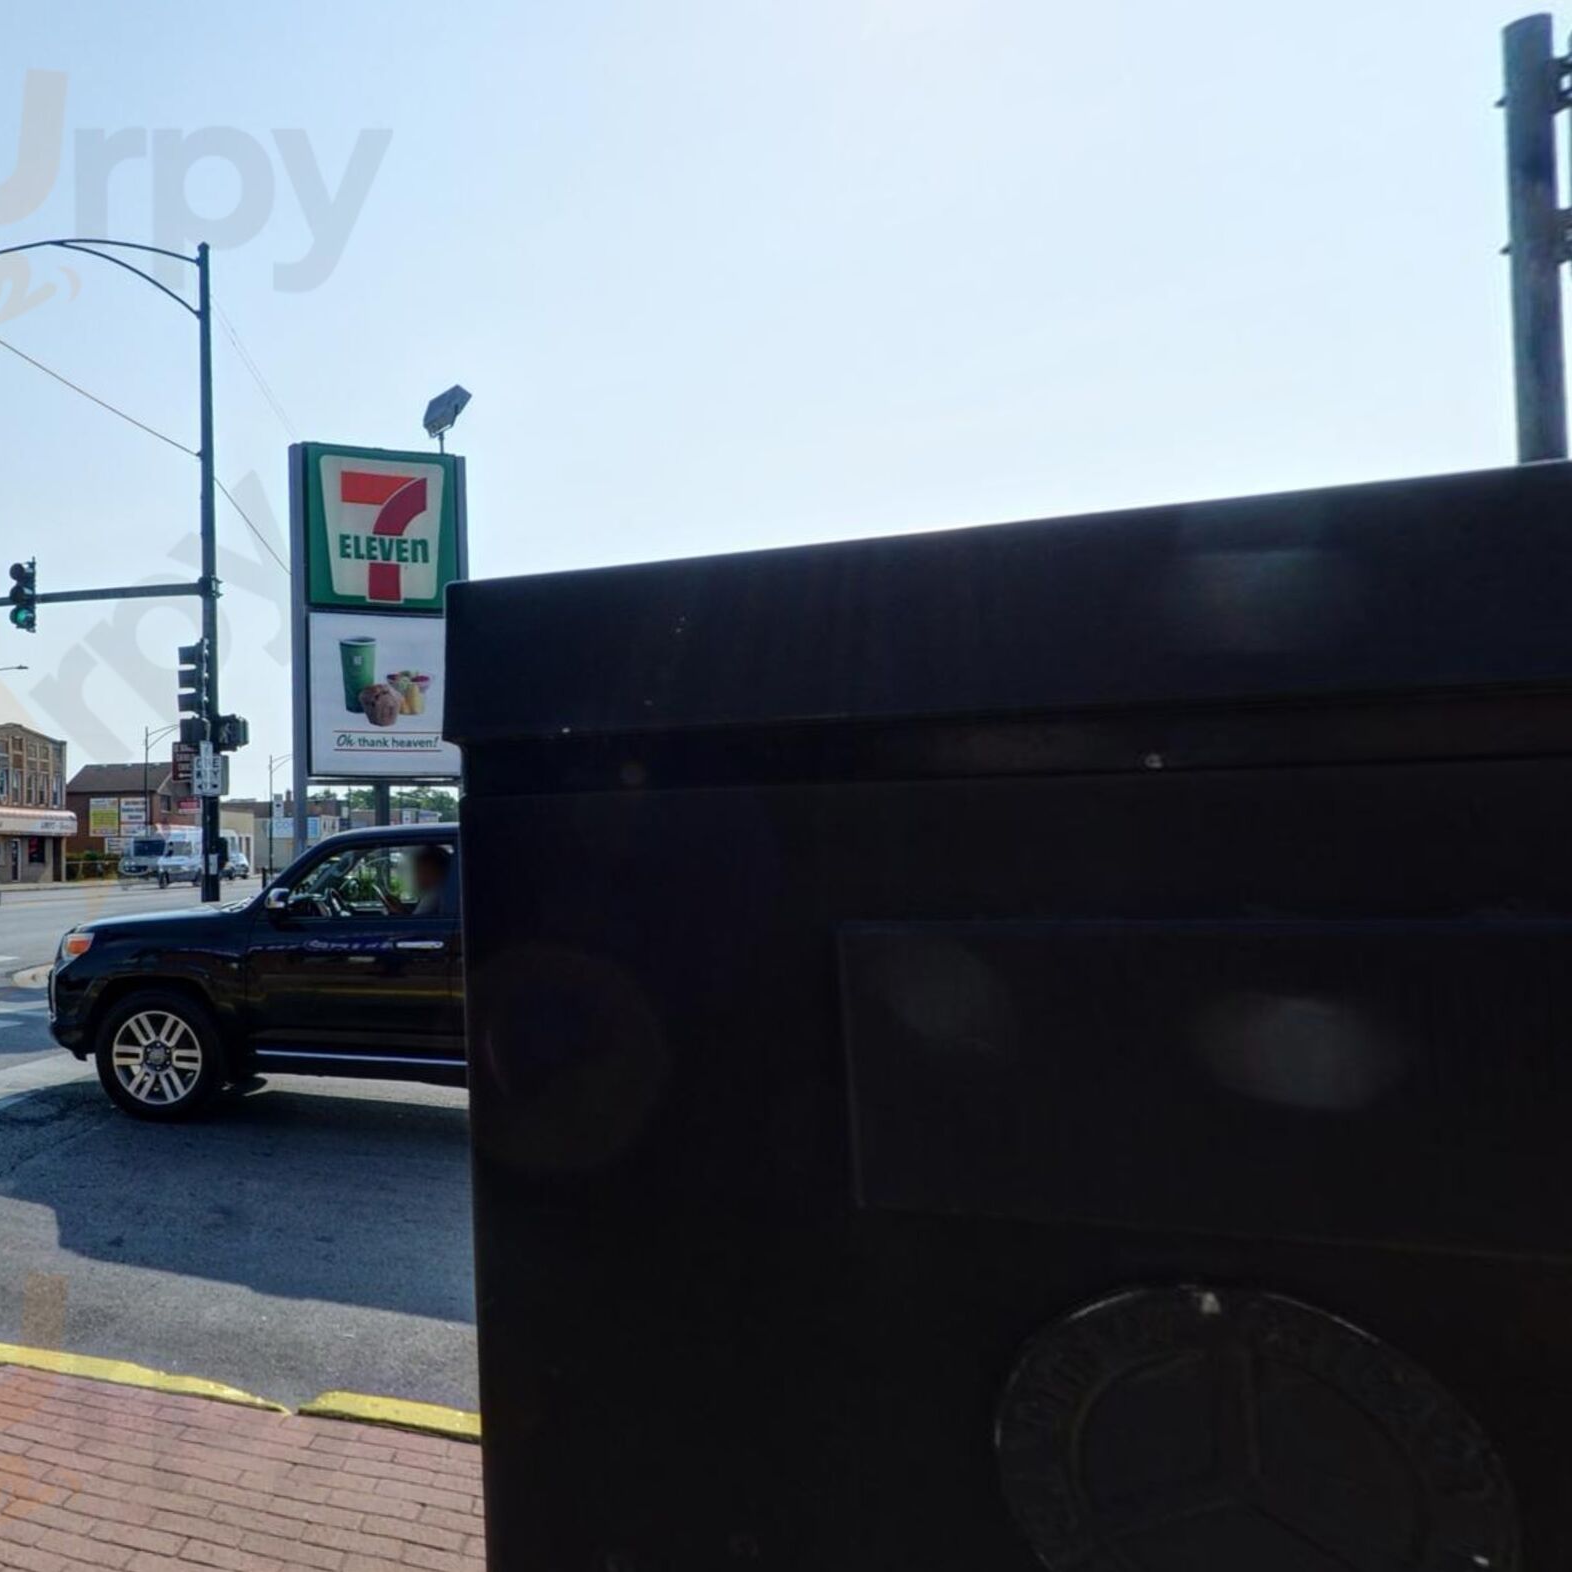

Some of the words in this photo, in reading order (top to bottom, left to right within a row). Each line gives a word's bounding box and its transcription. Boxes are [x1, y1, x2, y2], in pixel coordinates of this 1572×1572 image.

[340, 470, 427, 602] 7
[336, 733, 354, 747] Oh
[358, 736, 389, 748] thank
[392, 735, 440, 748] heaven!
